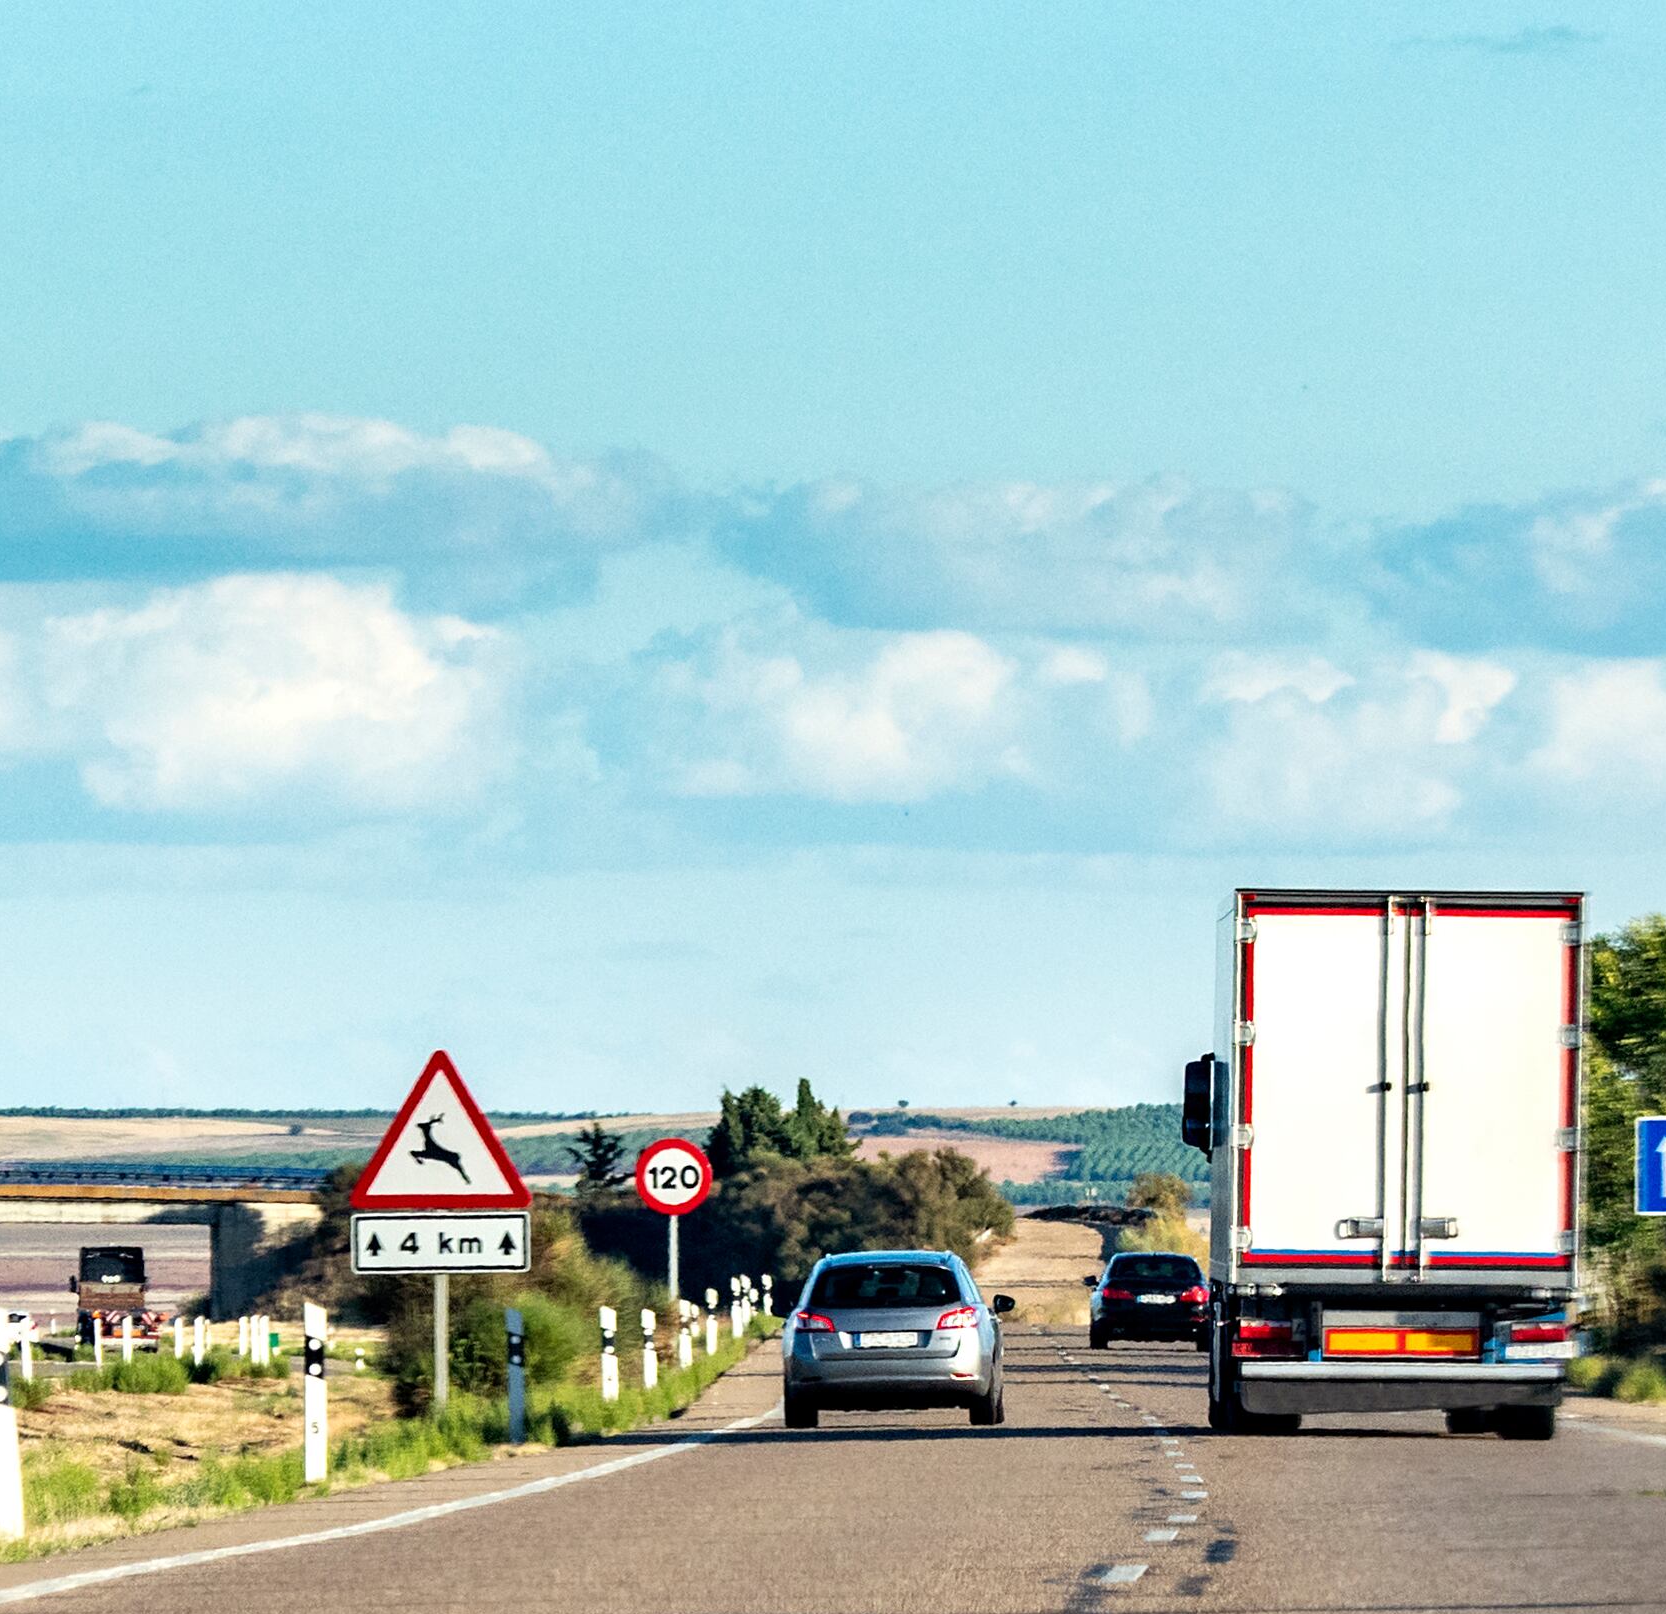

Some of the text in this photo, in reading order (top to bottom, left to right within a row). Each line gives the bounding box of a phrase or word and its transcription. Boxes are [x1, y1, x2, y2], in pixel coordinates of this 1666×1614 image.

[648, 1165, 700, 1189] 120
[399, 1231, 482, 1255] 4 km
[311, 1421, 320, 1434] 5
